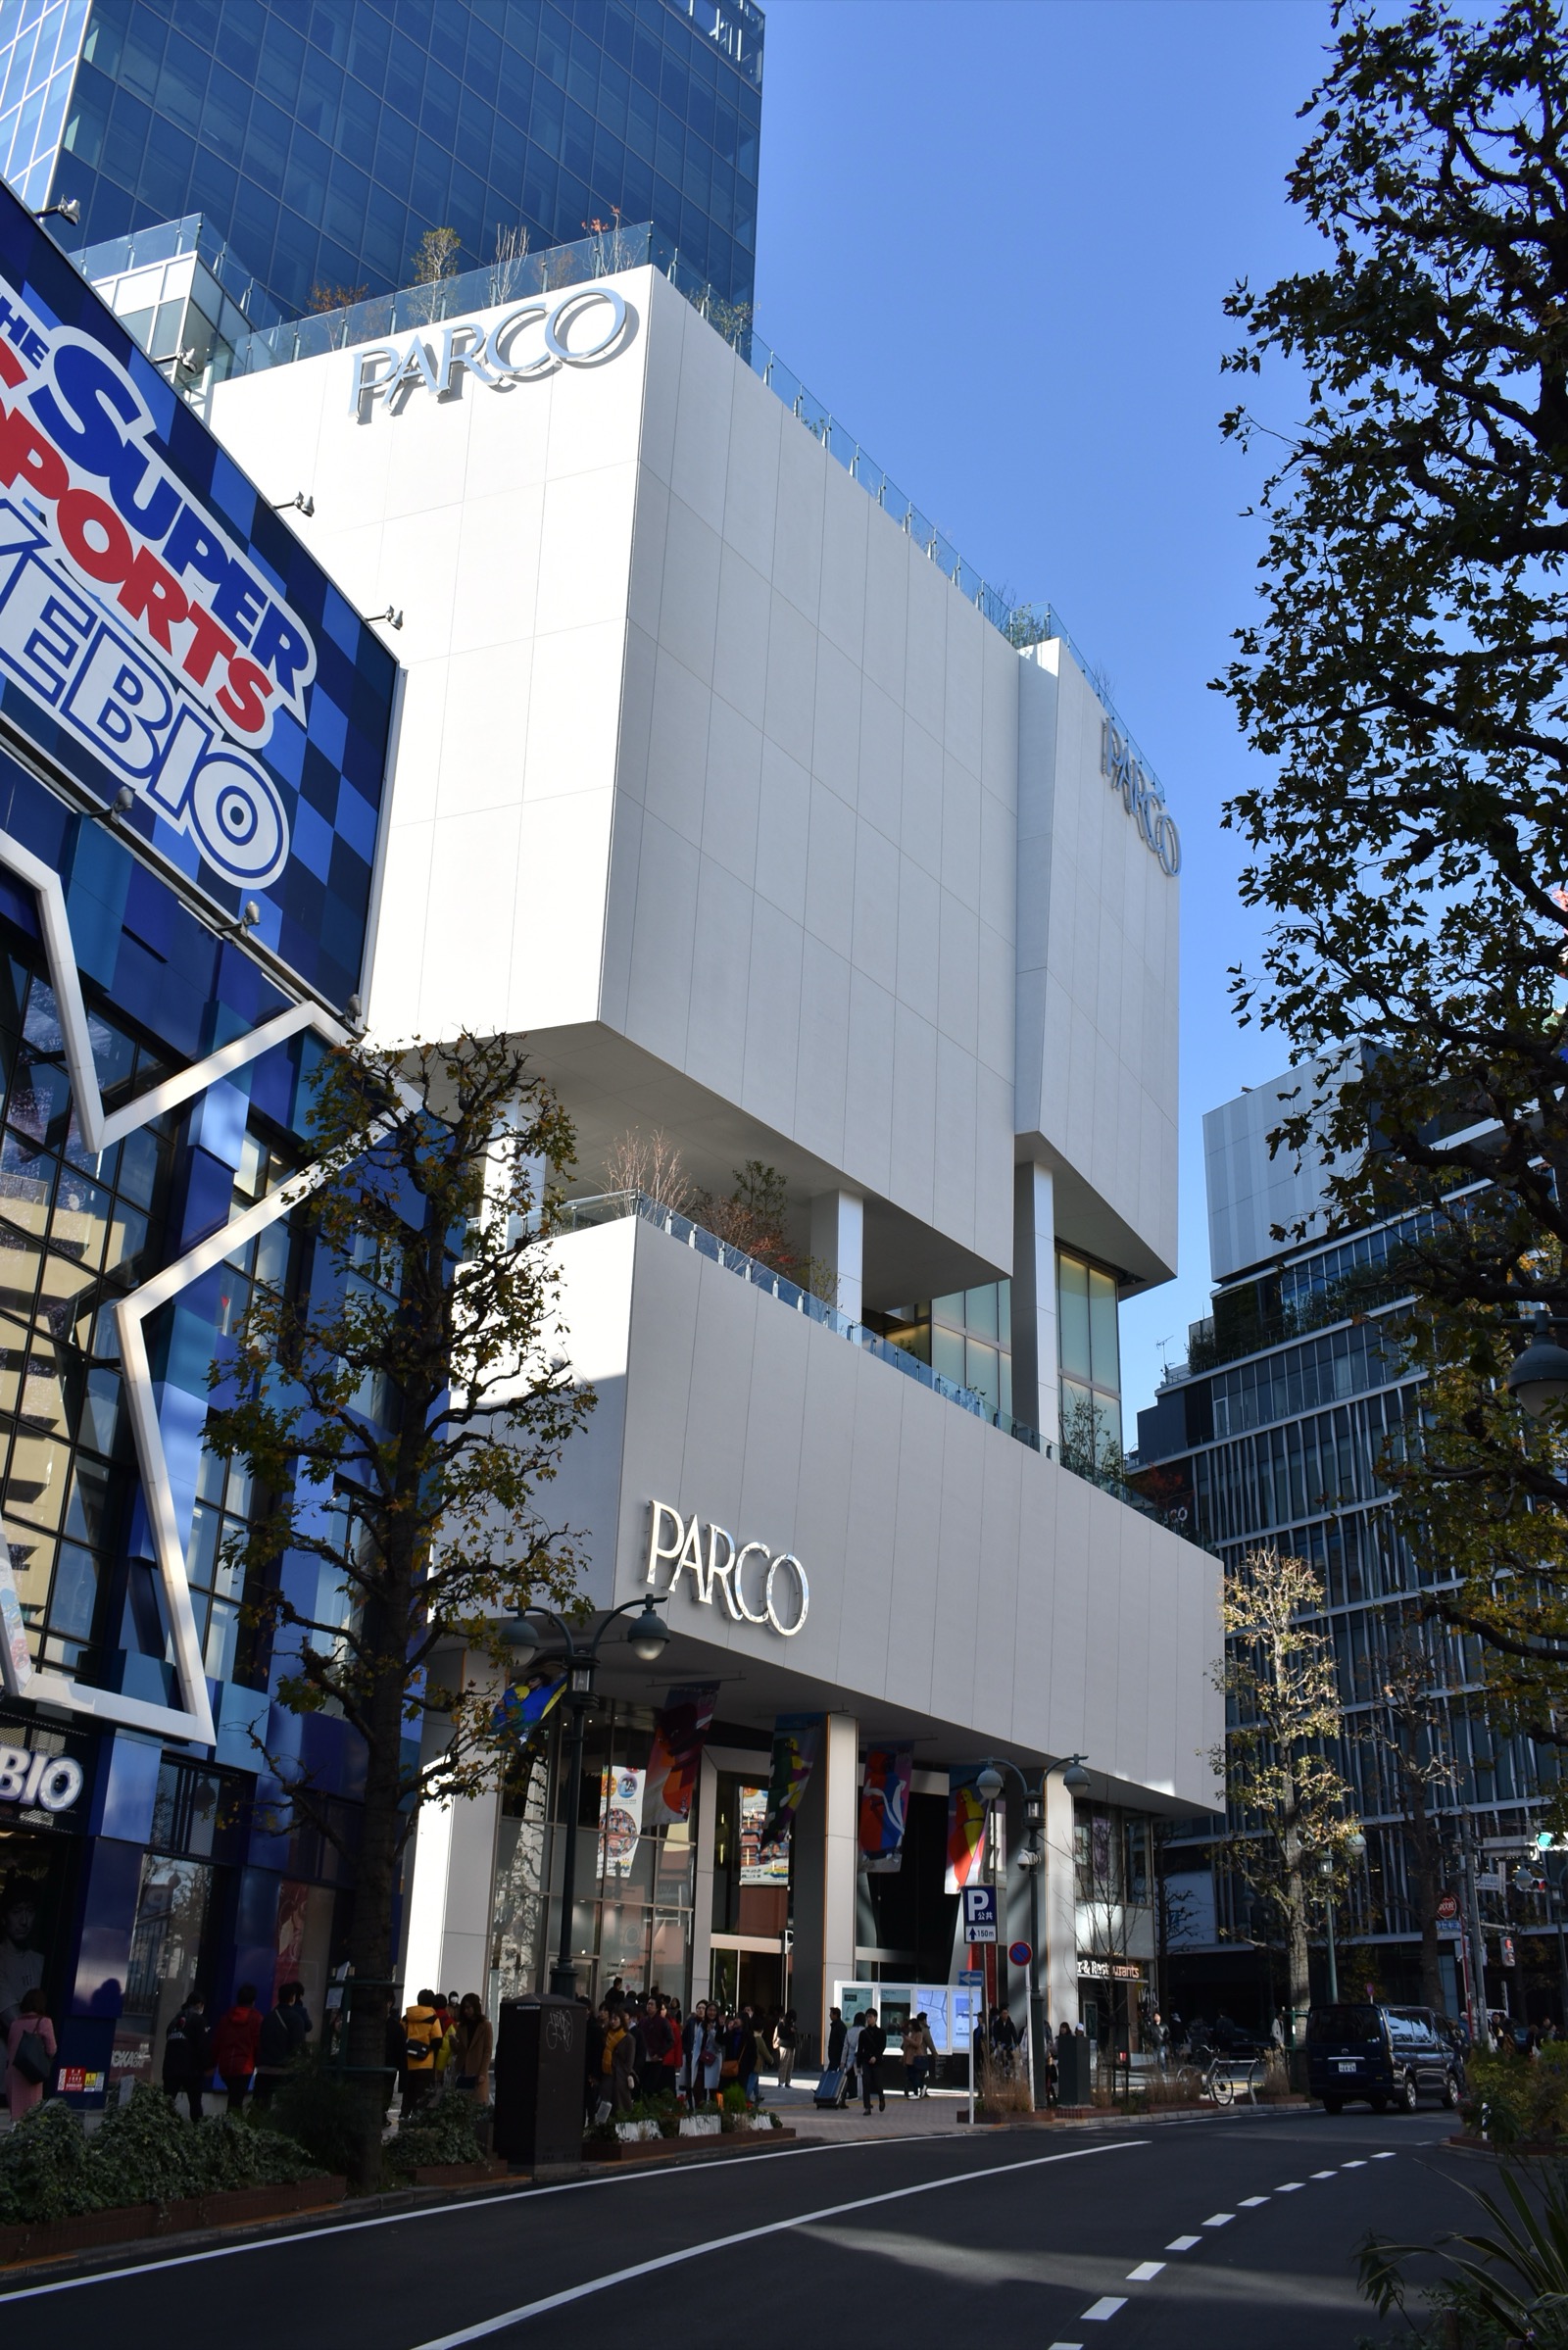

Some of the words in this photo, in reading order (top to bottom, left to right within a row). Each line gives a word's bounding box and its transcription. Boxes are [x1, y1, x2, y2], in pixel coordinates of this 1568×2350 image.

[0, 298, 51, 370] HE
[348, 287, 626, 418] PARCO
[0, 337, 274, 734] PORTS
[27, 344, 310, 687] SUPER
[1102, 716, 1182, 877] PARCO
[646, 1499, 809, 1637] PARCO
[0, 1744, 84, 1813] BIO
[967, 1889, 989, 1922] P
[977, 1911, 993, 1921] 公共
[1091, 1961, 1140, 1979] Resturants
